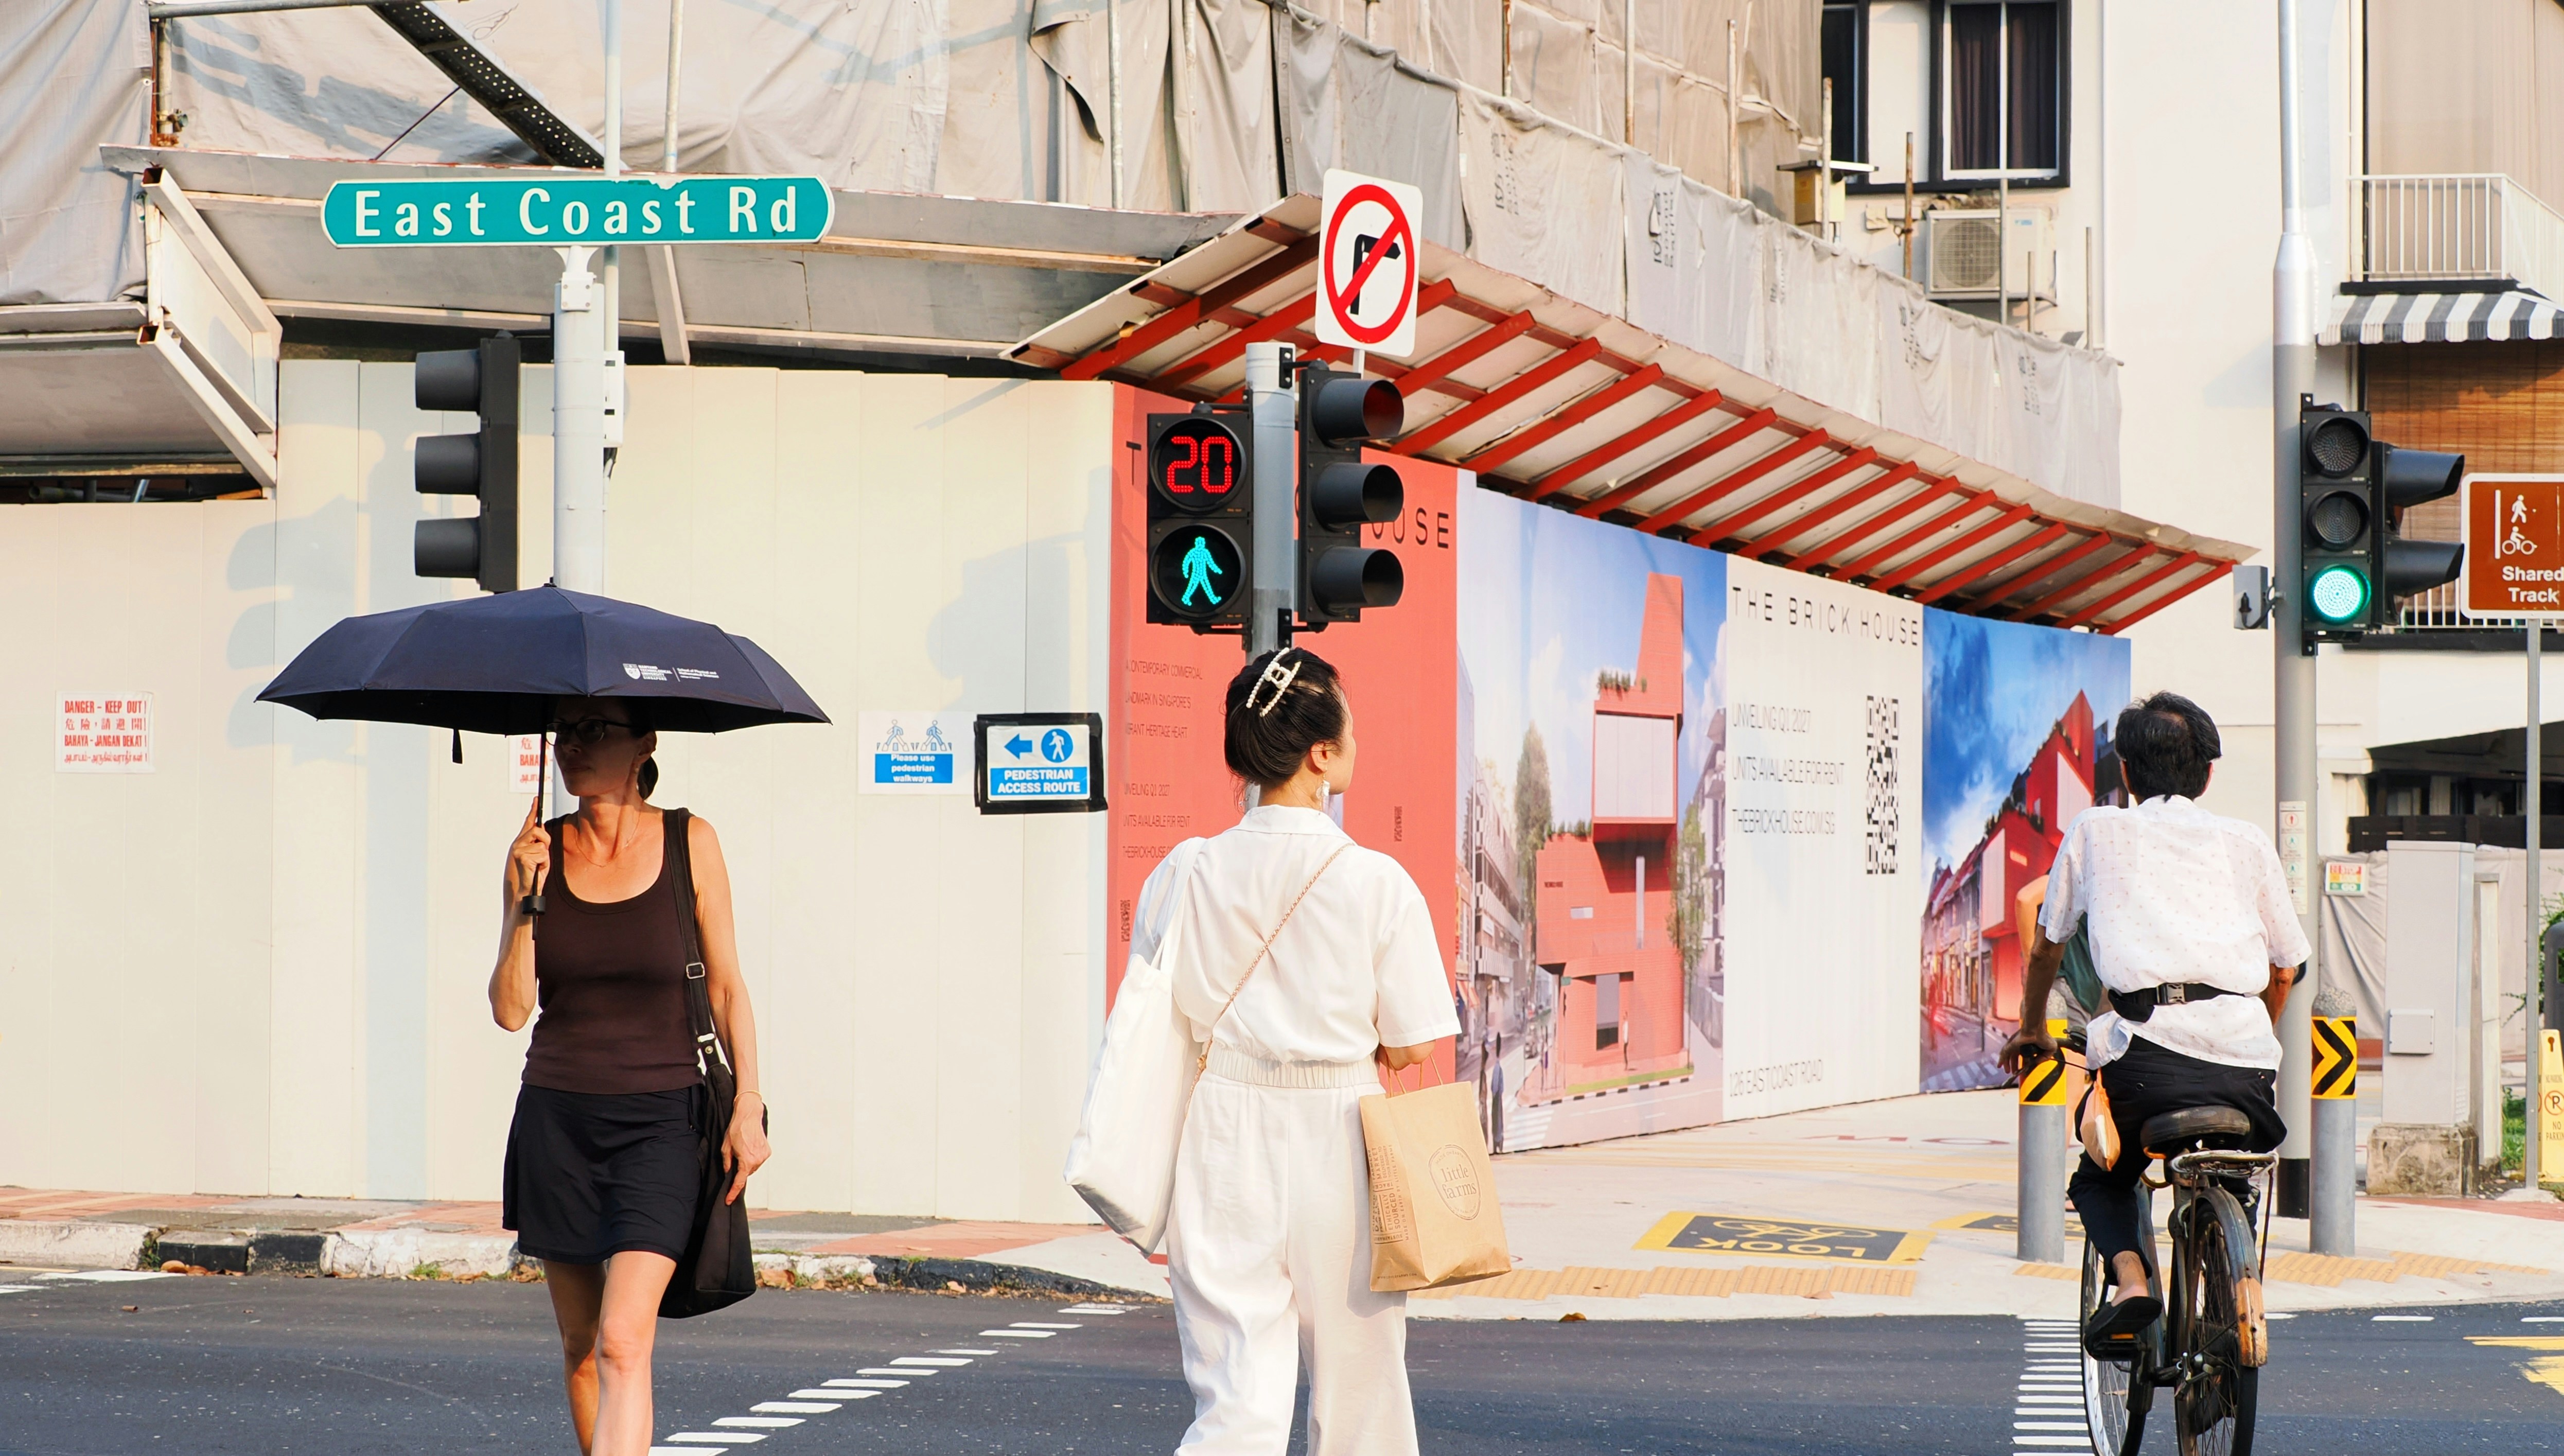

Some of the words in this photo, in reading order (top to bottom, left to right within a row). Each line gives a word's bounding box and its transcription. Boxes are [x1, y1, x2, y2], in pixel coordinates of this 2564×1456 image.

[356, 190, 485, 237] East
[520, 187, 695, 235] Coast
[729, 185, 797, 234] Rd
[1167, 436, 1232, 494] 20
[2502, 565, 2564, 582] Shared
[2508, 587, 2559, 603] Track
[1732, 586, 1773, 622] THE
[1788, 597, 1850, 635] BRICK
[1860, 609, 1918, 646] HOUSE
[65, 700, 95, 714] DANGER
[105, 700, 122, 714] KEEP
[64, 735, 88, 747] BAHAYA
[95, 735, 120, 747] JANGAN
[520, 754, 548, 766] BAHA
[1732, 756, 1757, 781] UNITS
[891, 764, 935, 774] pedestrian
[1004, 769, 1074, 781] PEDESTRIAN
[893, 774, 933, 783] walkways
[997, 782, 1042, 794] ACCESS
[1043, 781, 1081, 793] ROUTE
[1746, 1067, 1769, 1094] EAST
[2552, 1121, 2561, 1130] NO
[2545, 1132, 2564, 1141] PARKIN
[1372, 1147, 1382, 1180] MARKET
[1441, 1164, 1469, 1183] little
[1442, 1182, 1477, 1199] farms
[1382, 1194, 1394, 1231] ETHICALLY
[1389, 1192, 1401, 1229] SOURCED
[1697, 1237, 1866, 1257] LOOK
